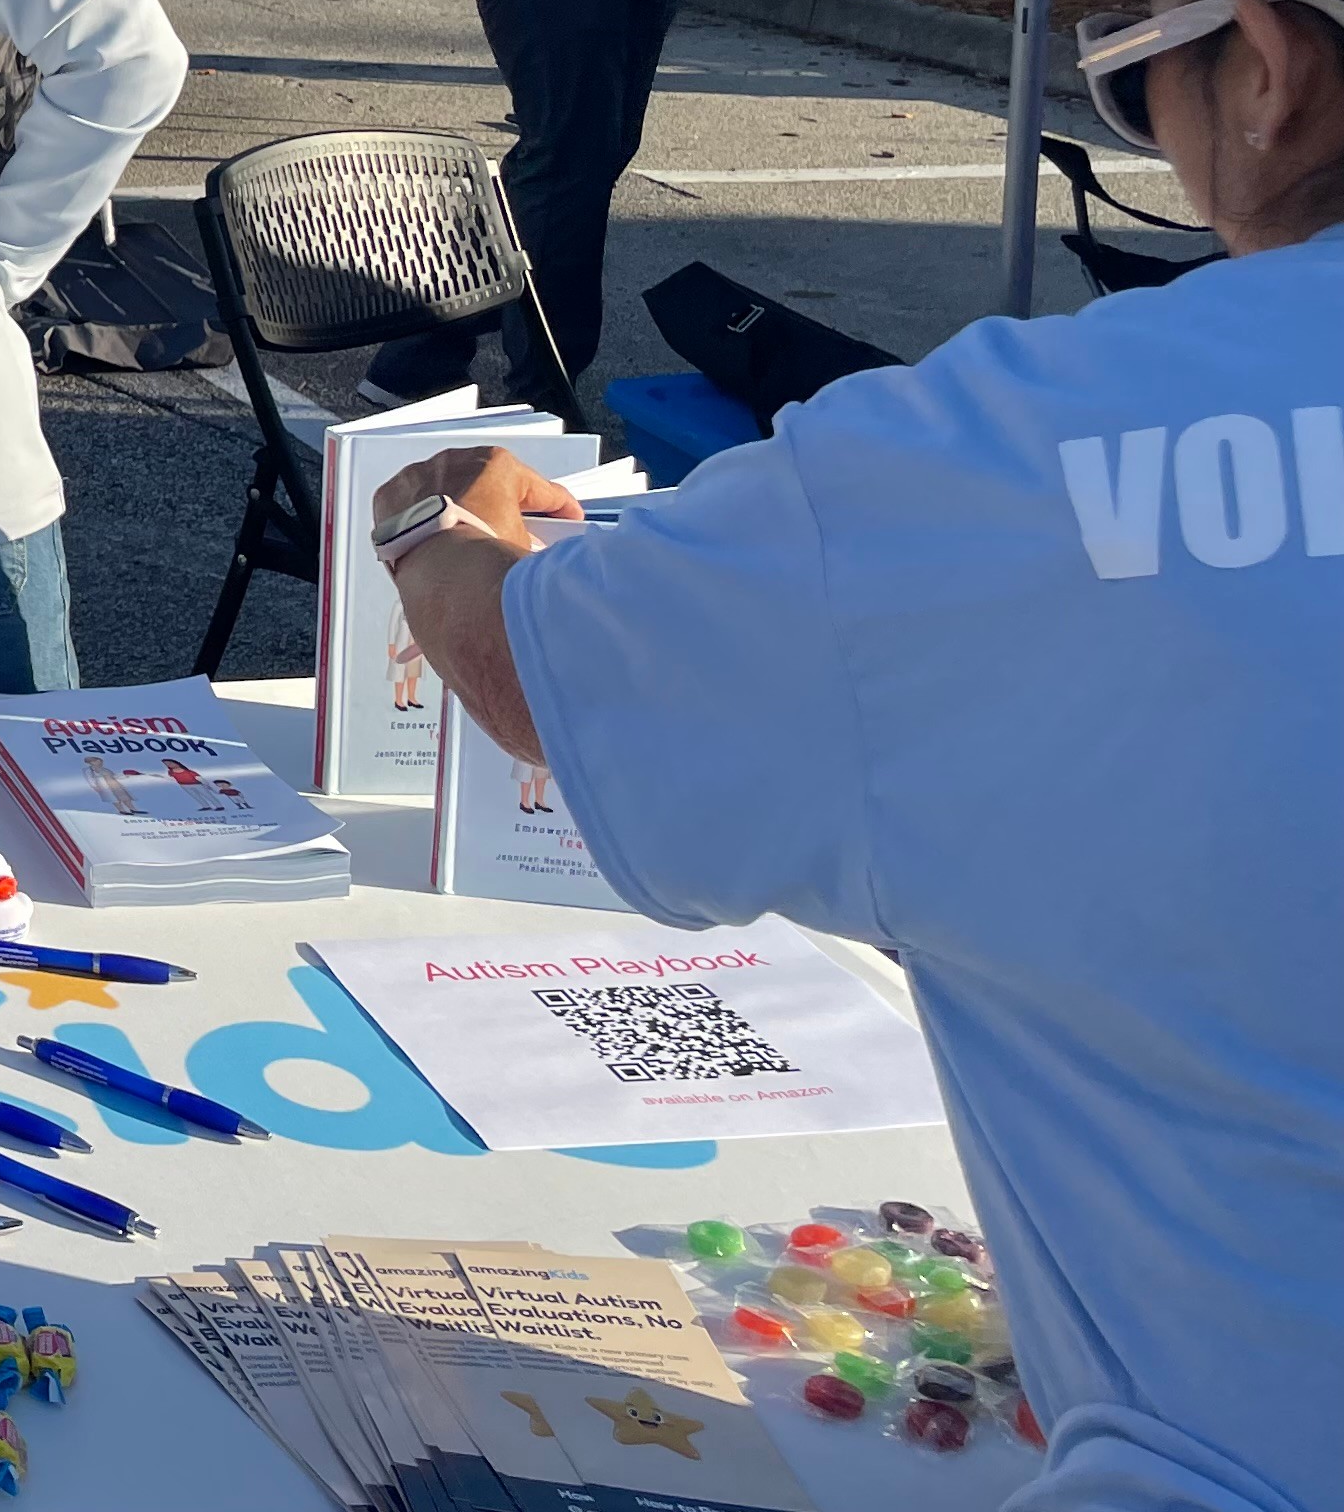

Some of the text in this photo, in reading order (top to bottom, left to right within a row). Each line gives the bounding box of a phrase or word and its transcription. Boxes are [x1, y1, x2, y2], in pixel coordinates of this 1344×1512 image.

[43, 715, 188, 737] Autism
[41, 736, 218, 756] Playbook
[424, 948, 772, 983] Autism Playbook
[642, 1084, 834, 1106] available on Amazon
[467, 1263, 591, 1281] amazingKids
[478, 1285, 662, 1311] Virtual Autism
[490, 1303, 683, 1330] Evaluations, No
[497, 1320, 602, 1340] Waitlist.
